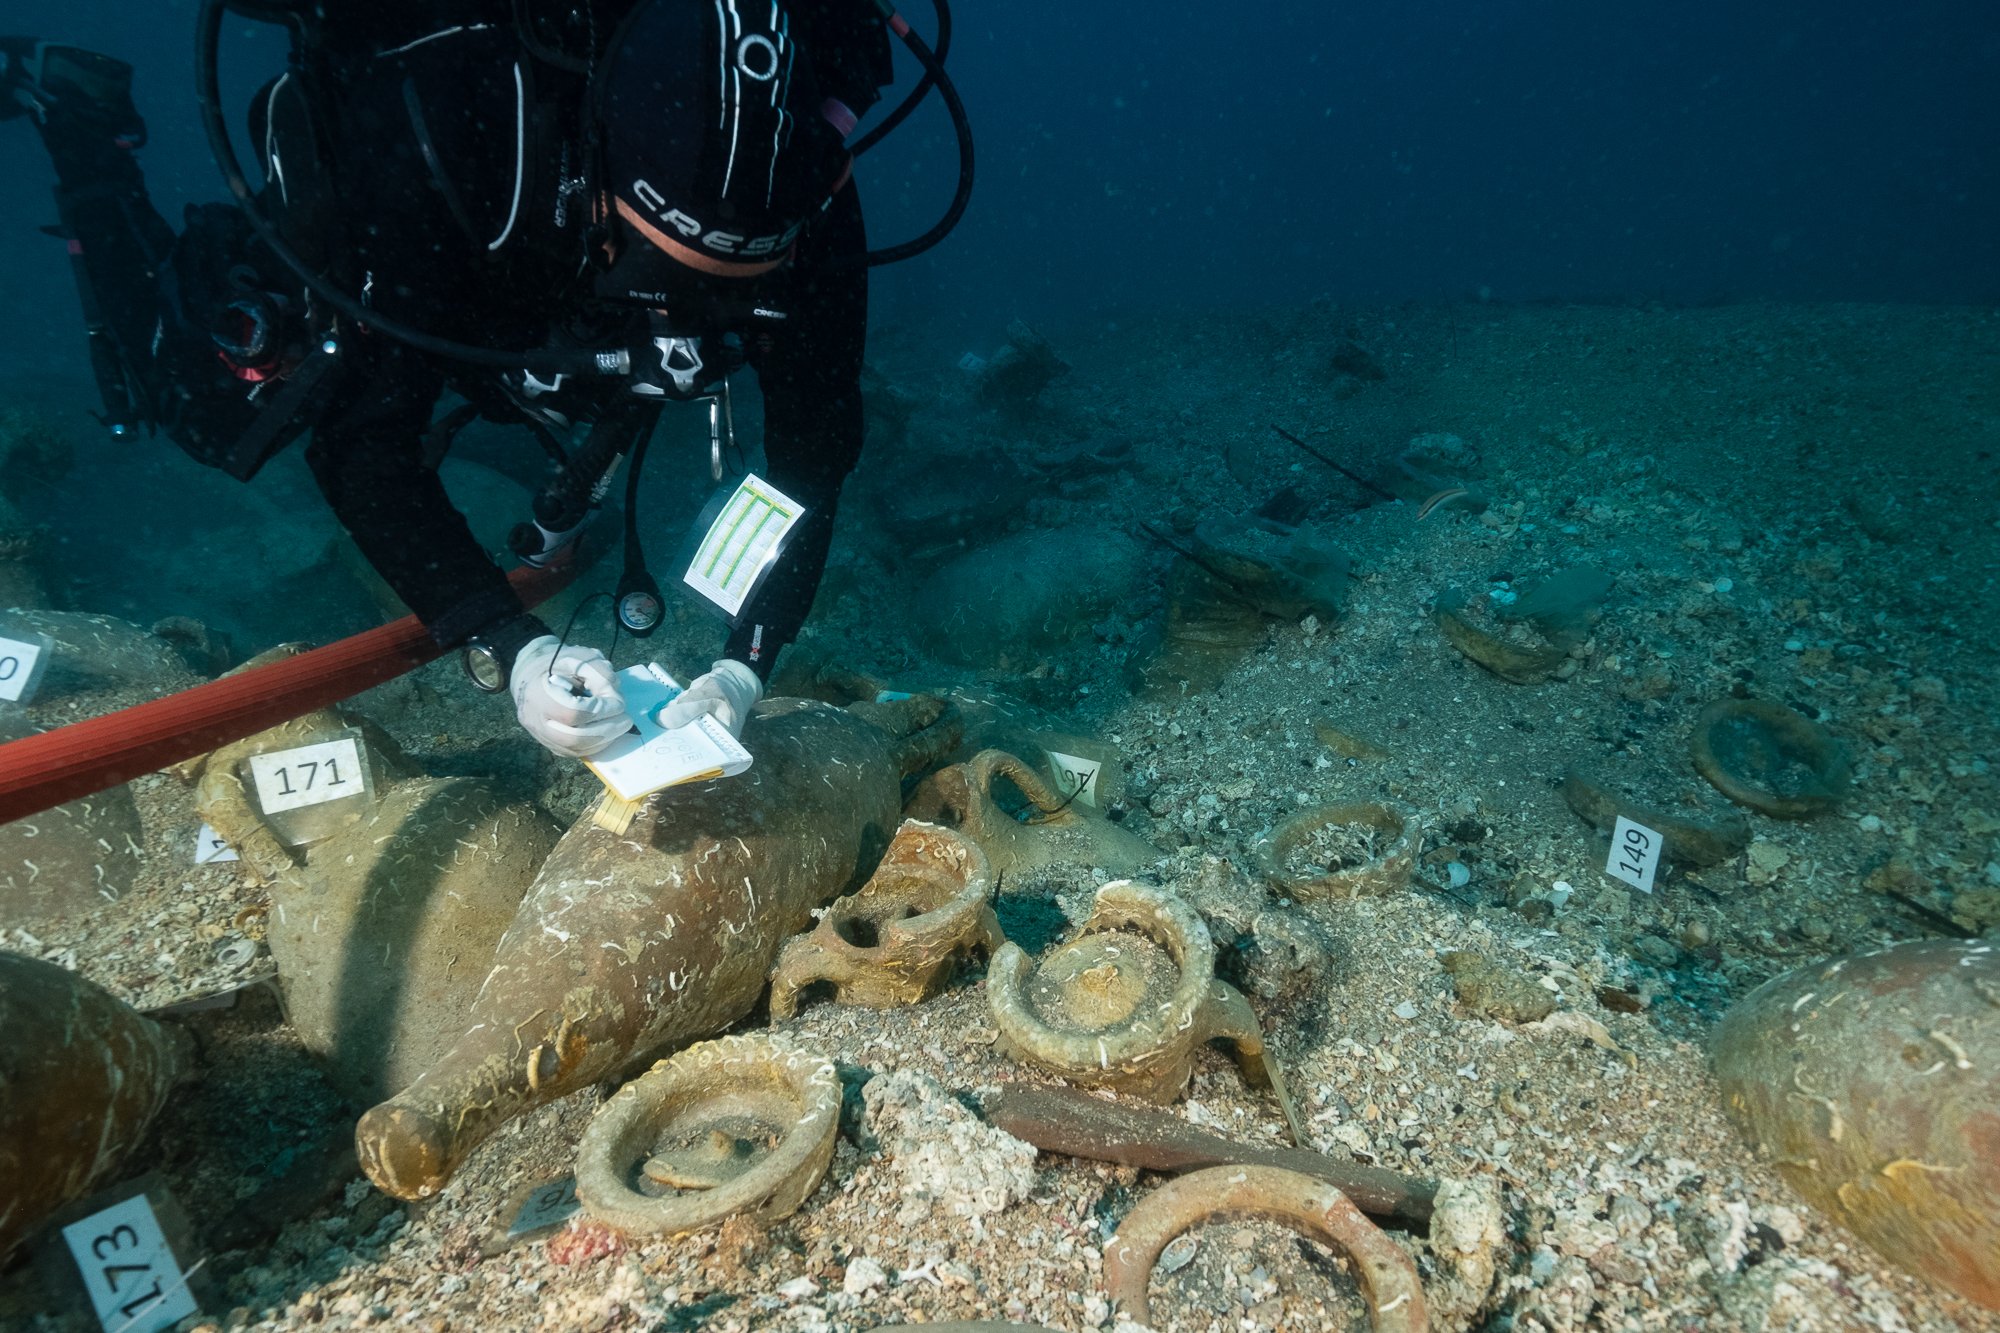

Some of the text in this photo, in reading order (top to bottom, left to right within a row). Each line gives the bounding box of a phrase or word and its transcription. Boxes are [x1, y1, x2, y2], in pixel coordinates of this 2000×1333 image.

[273, 757, 347, 796] 171
[1619, 828, 1650, 879] 149
[92, 1224, 166, 1319] 173
